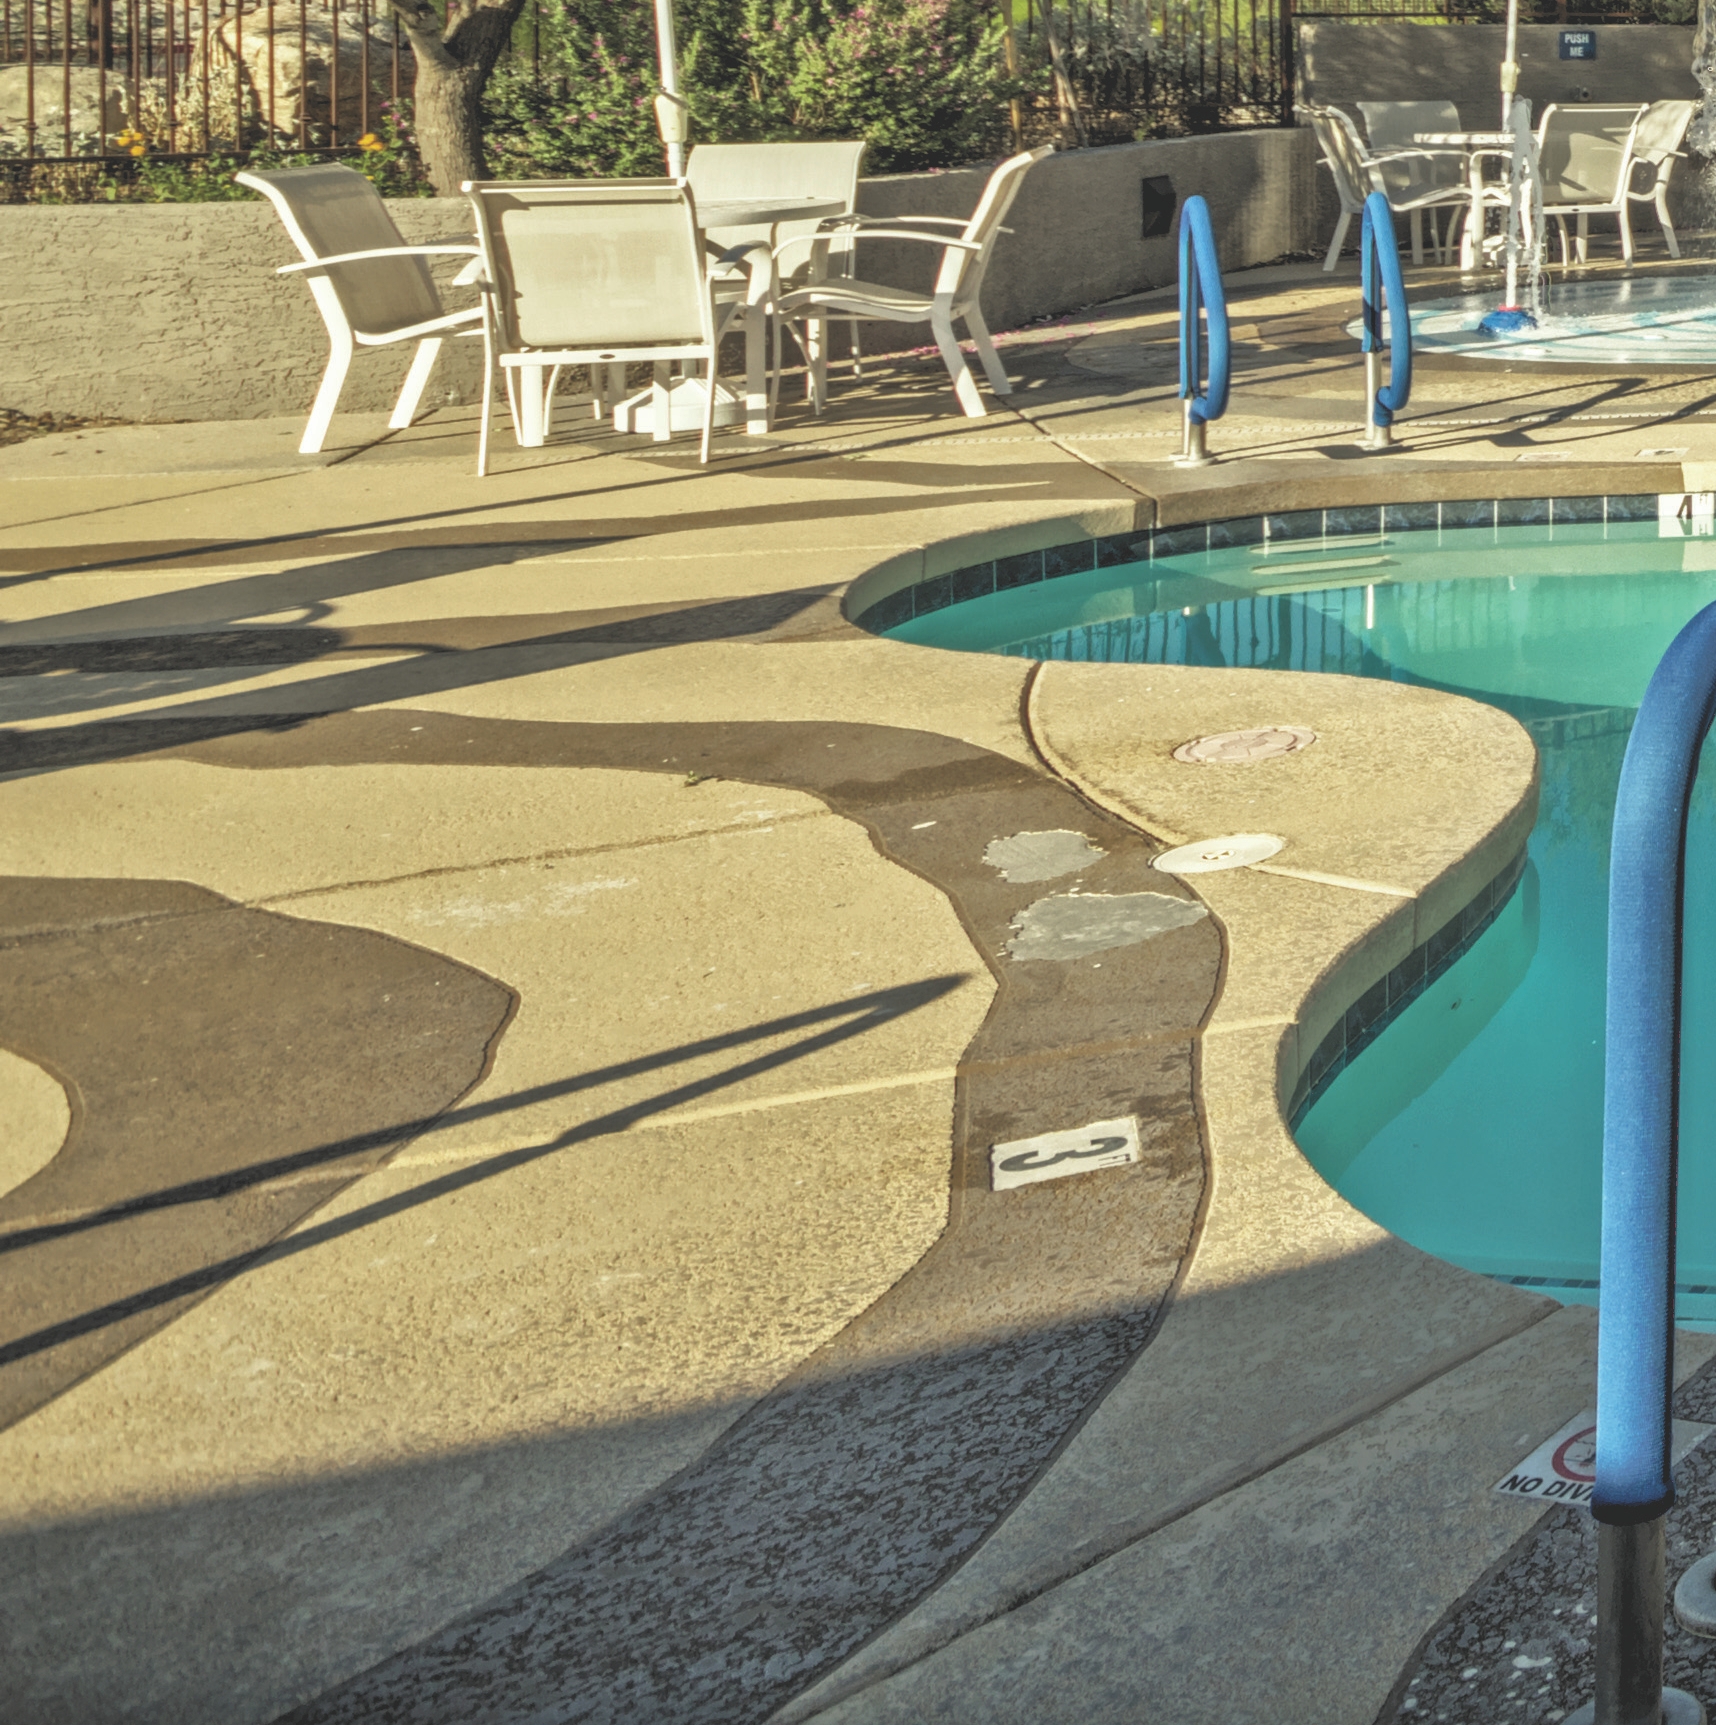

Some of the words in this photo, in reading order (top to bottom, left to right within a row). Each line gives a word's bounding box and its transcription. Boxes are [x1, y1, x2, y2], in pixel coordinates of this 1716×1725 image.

[1565, 34, 1589, 44] PUSH
[1570, 46, 1584, 57] ME
[999, 1137, 1128, 1172] 3
[1098, 1154, 1131, 1166] FT
[1500, 1475, 1543, 1493] NO
[1541, 1481, 1595, 1502] DIV
